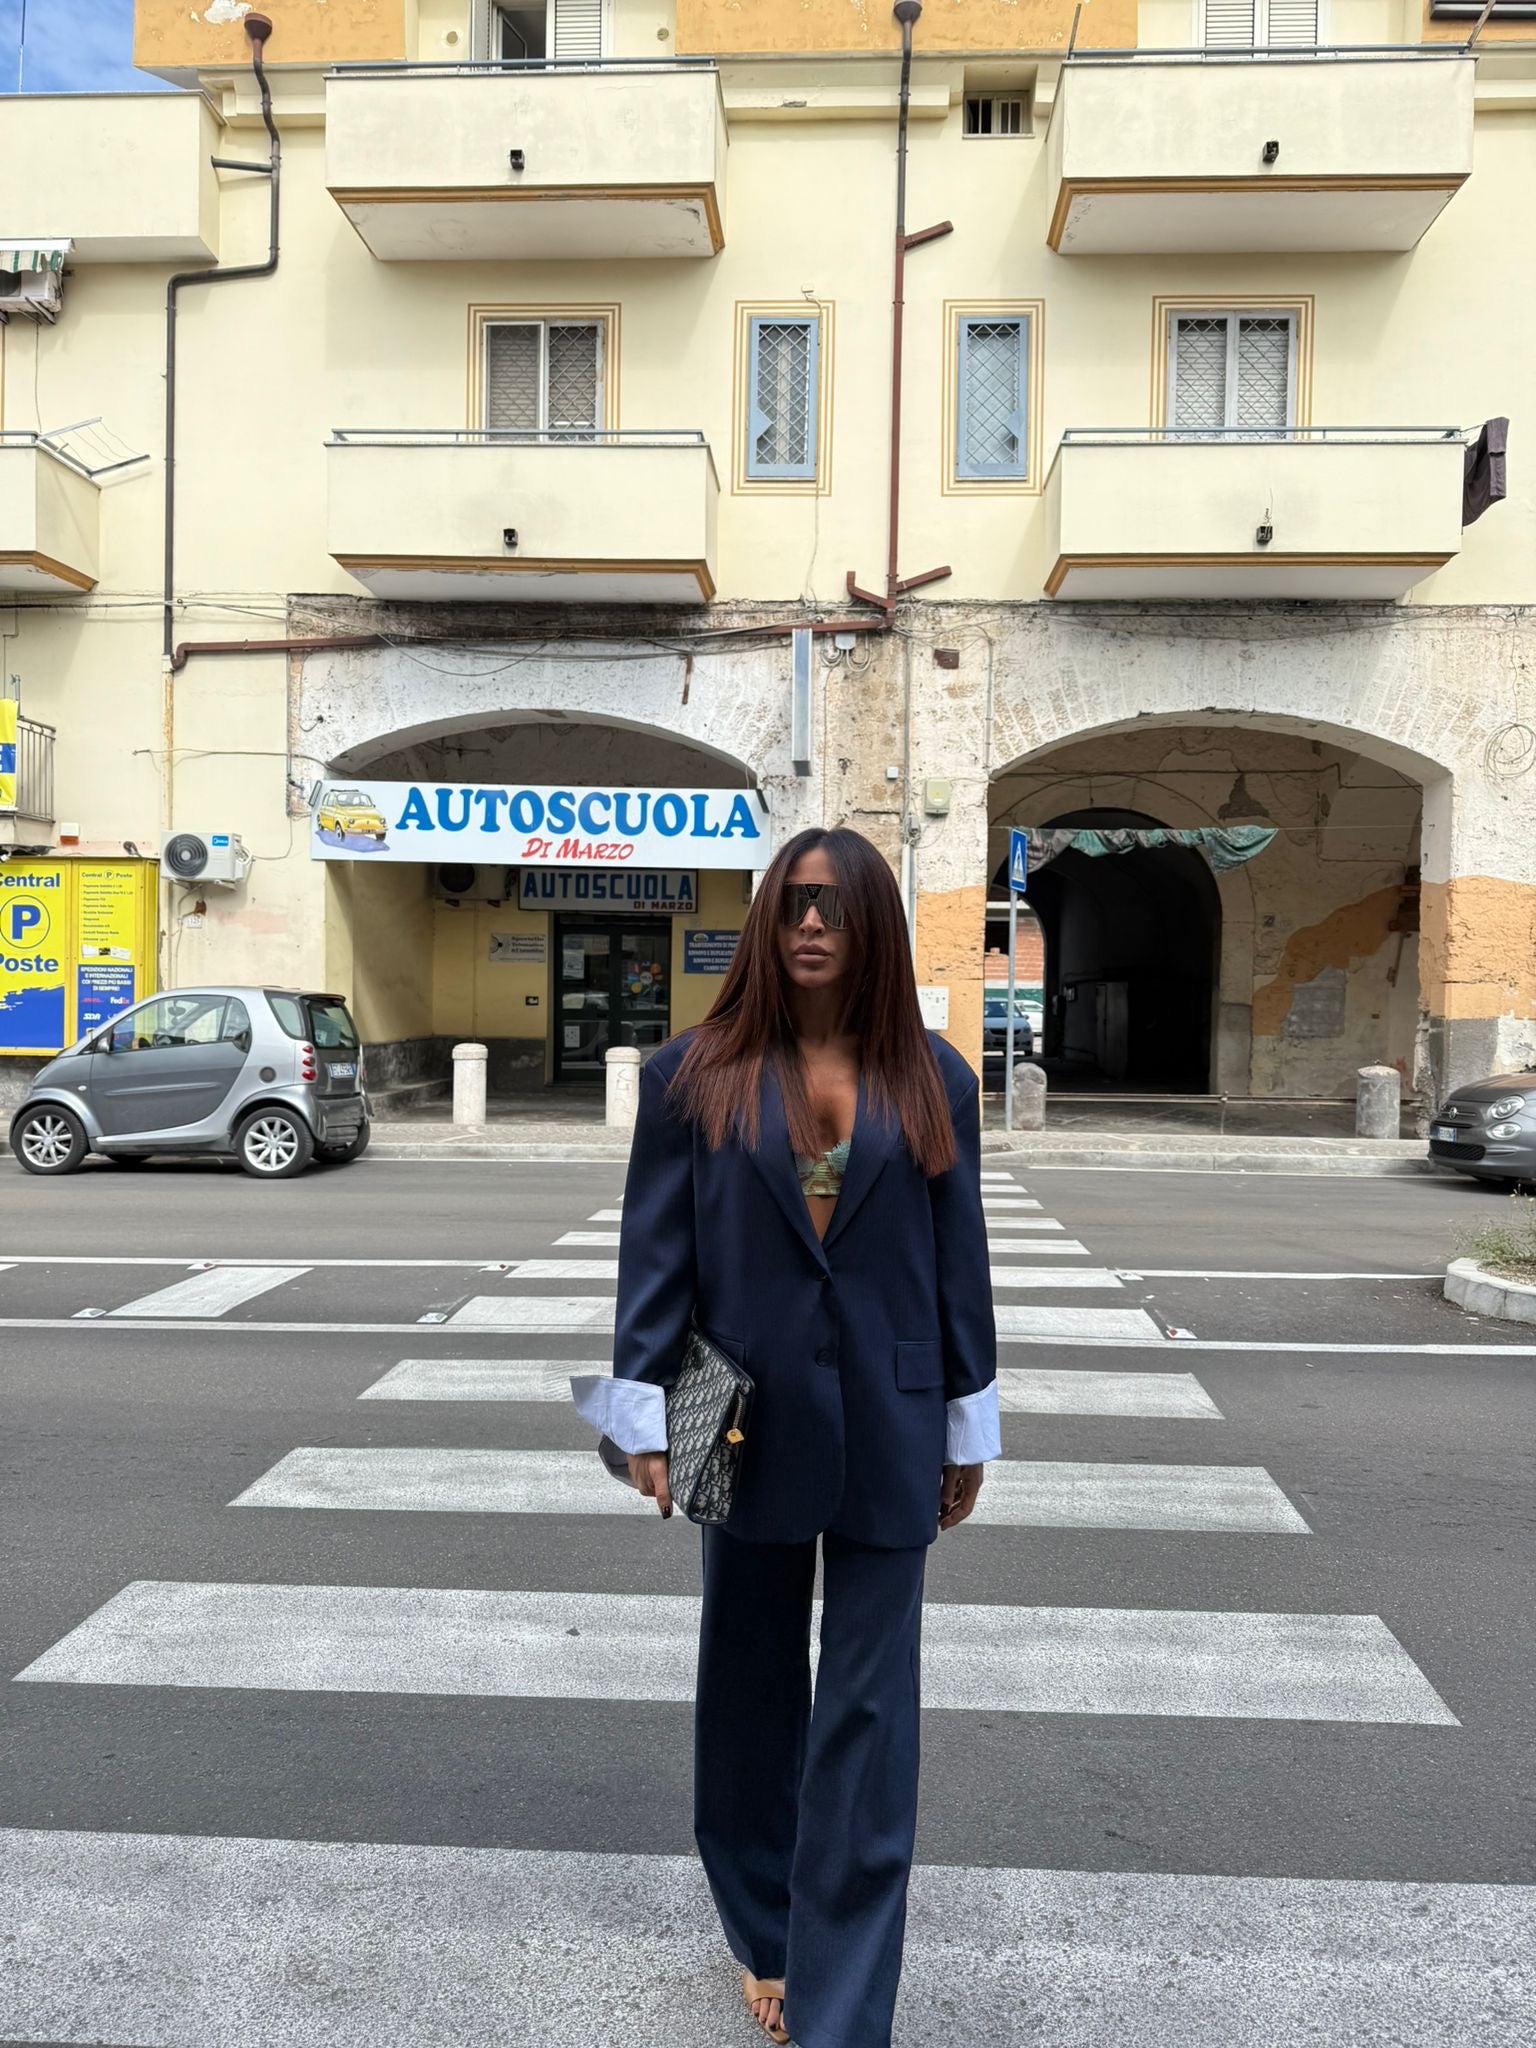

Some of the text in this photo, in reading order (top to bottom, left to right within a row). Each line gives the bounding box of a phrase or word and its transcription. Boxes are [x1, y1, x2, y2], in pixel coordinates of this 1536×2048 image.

[395, 786, 761, 838] AUTOSCUOLA
[521, 837, 634, 860] DI MARZO
[523, 872, 693, 900] AUTOSCUOLA
[633, 900, 693, 910] DI MARZO
[12, 904, 41, 940] P
